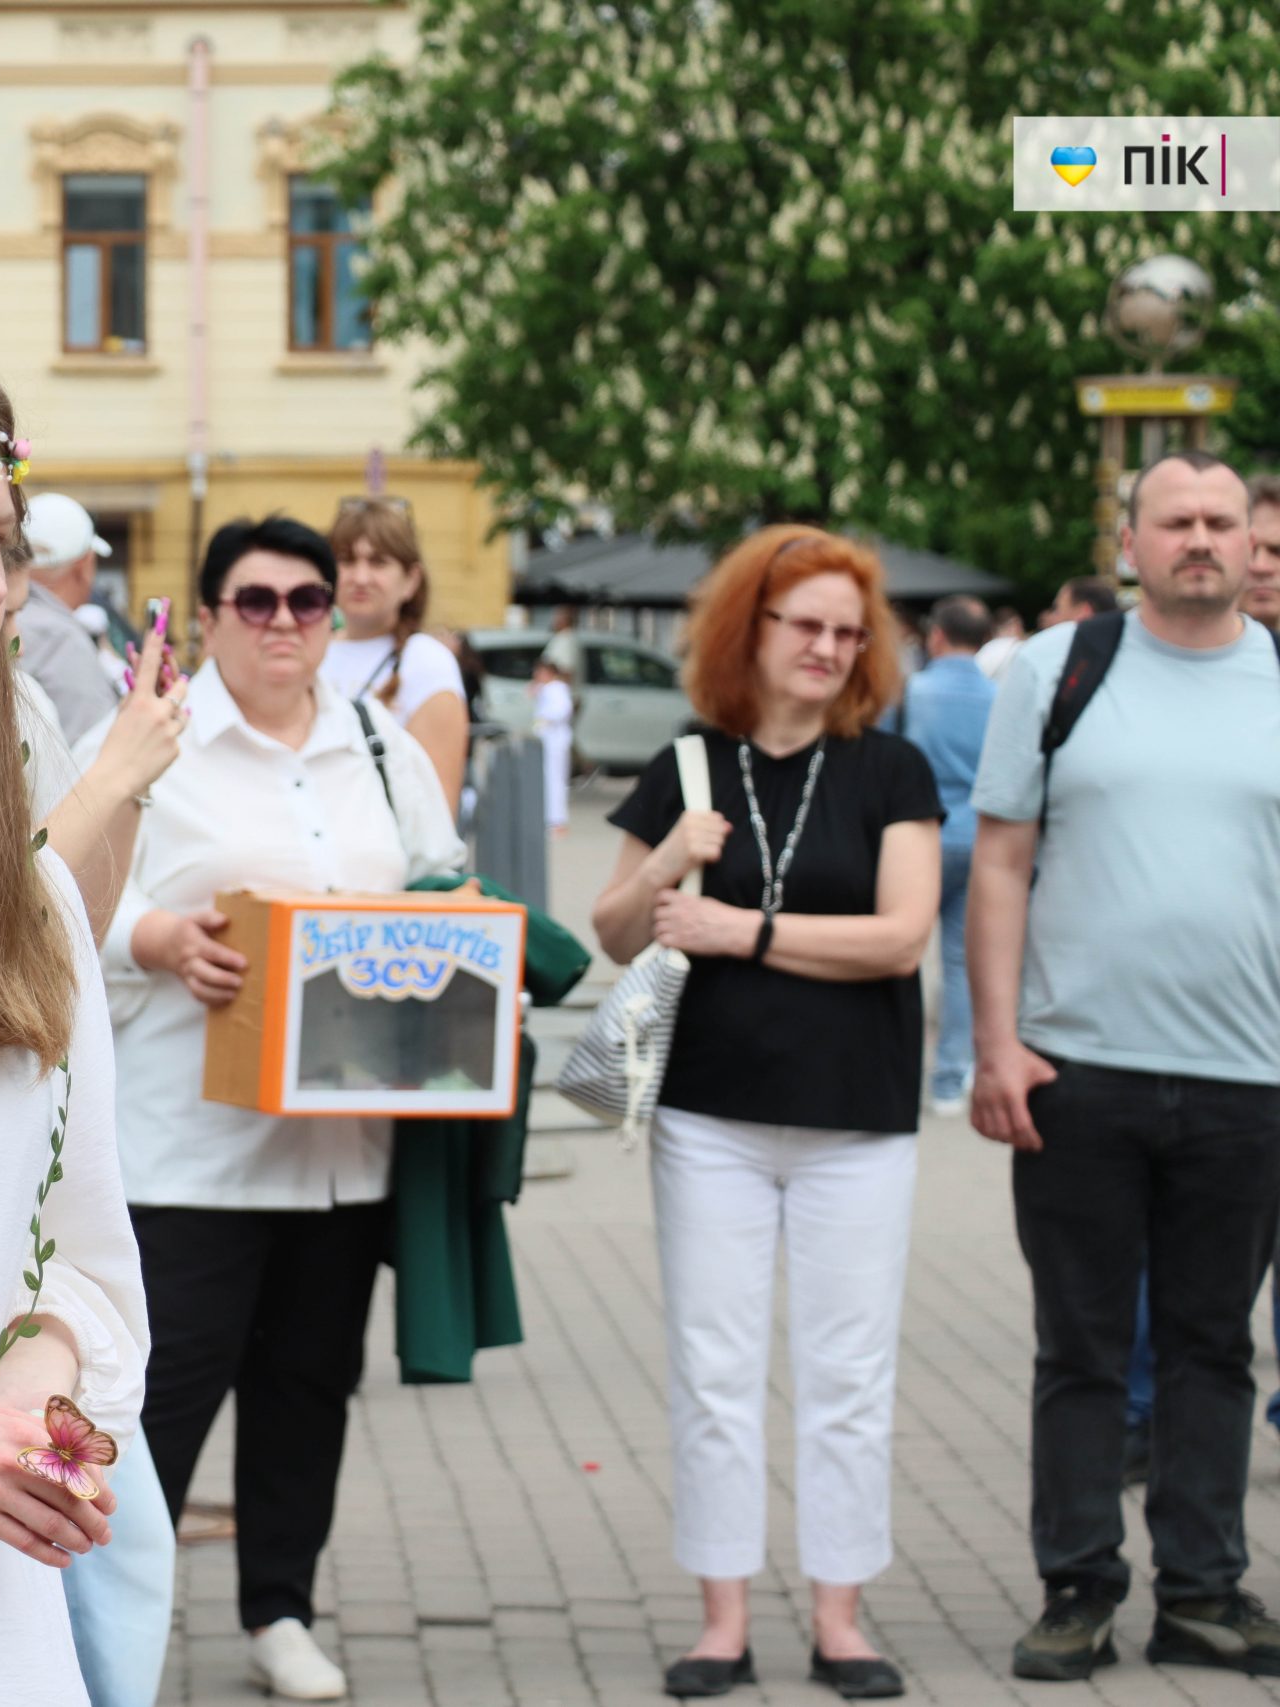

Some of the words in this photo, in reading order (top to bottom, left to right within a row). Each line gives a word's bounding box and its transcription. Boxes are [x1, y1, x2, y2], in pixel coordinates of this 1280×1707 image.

[302, 916, 373, 966] ЗБІР
[382, 917, 503, 970] КОШТІВ
[351, 956, 449, 989] ЗСУ
